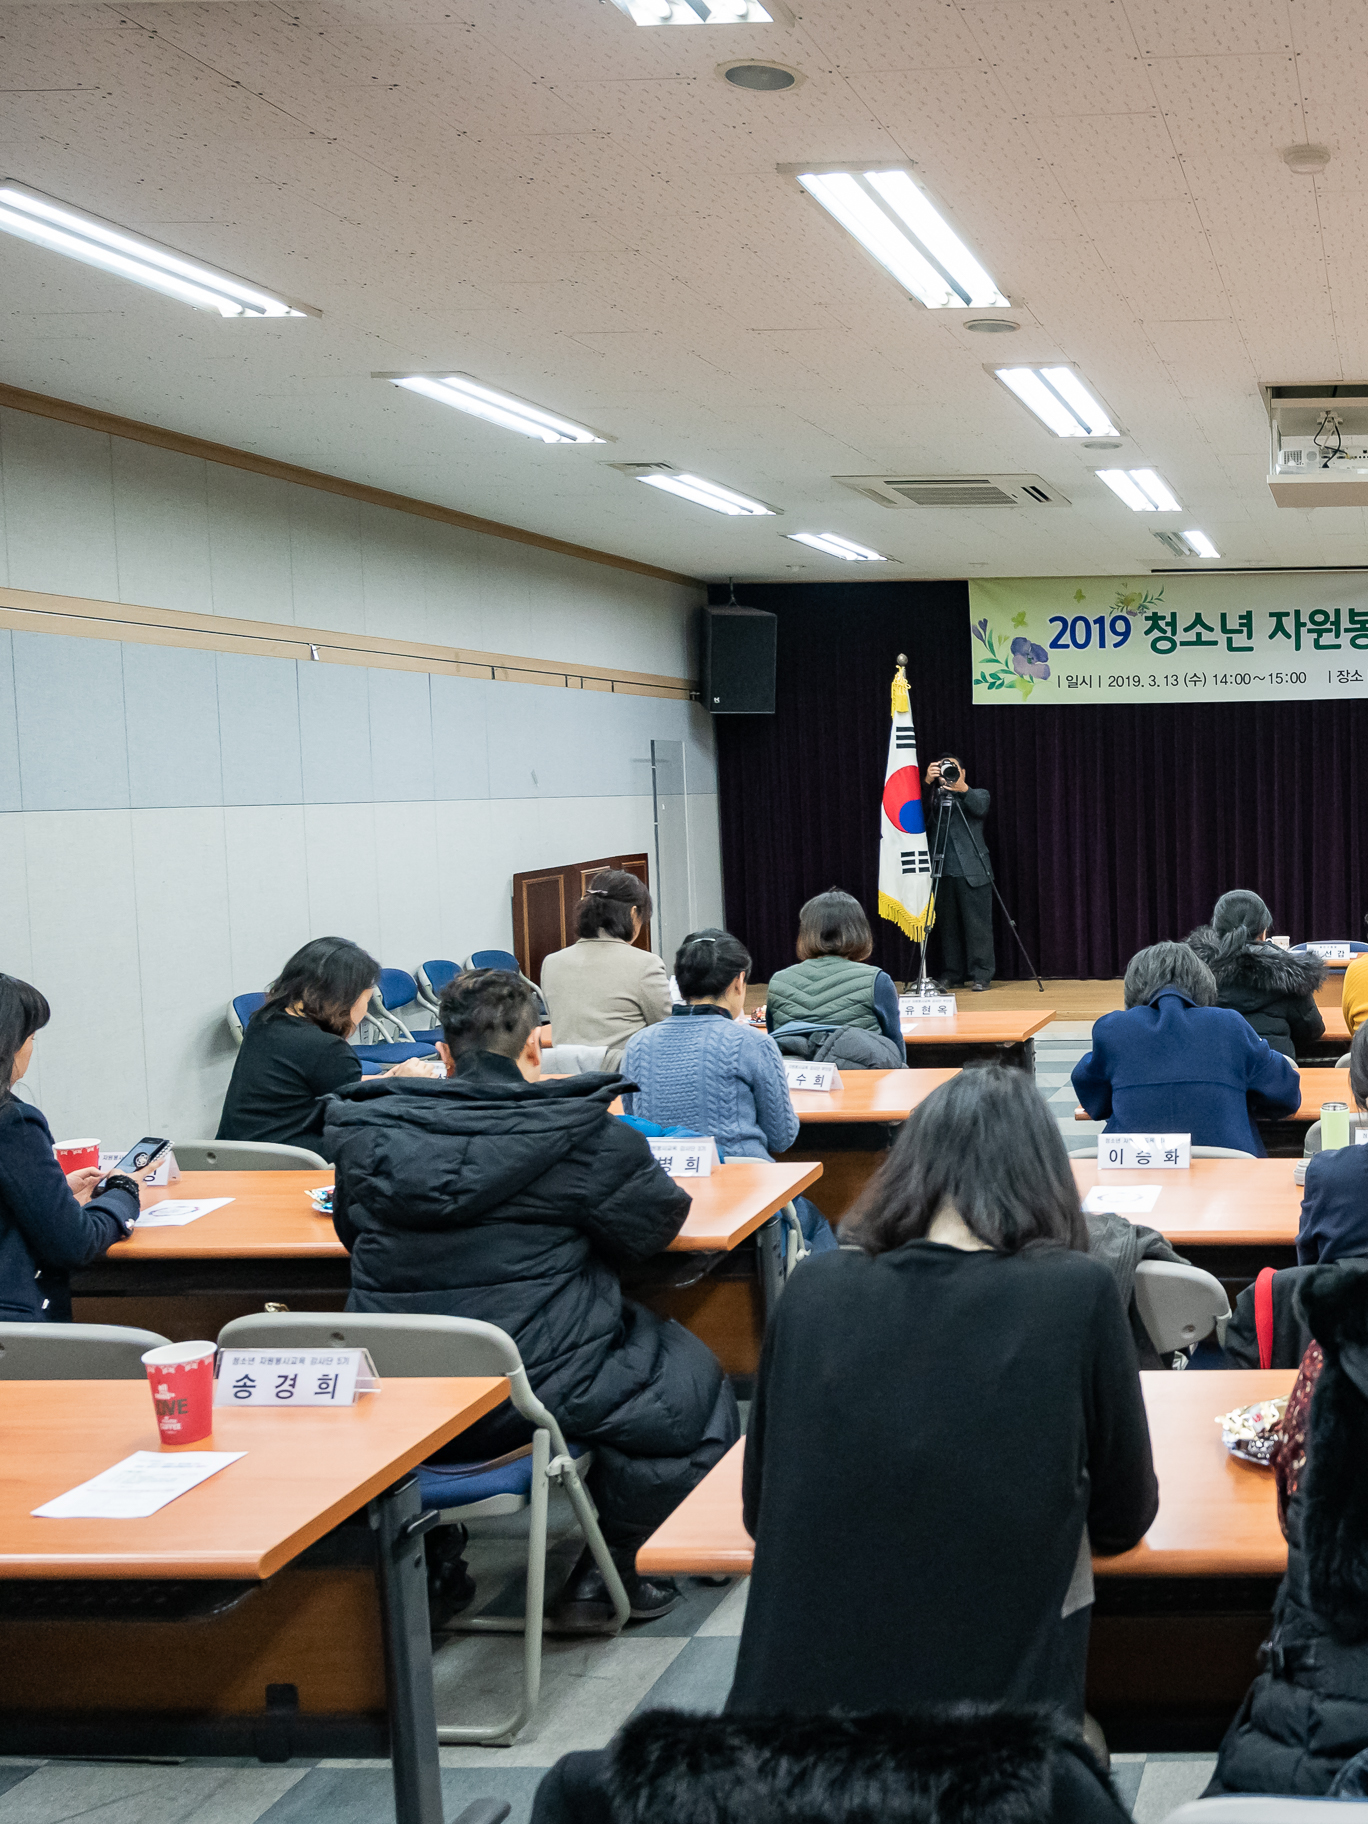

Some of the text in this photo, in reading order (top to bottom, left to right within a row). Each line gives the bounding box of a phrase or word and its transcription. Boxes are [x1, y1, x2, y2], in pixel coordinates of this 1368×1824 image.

[1048, 614, 1132, 650] 2019
[1143, 610, 1255, 655] 청소년
[1183, 672, 1207, 688] (수)
